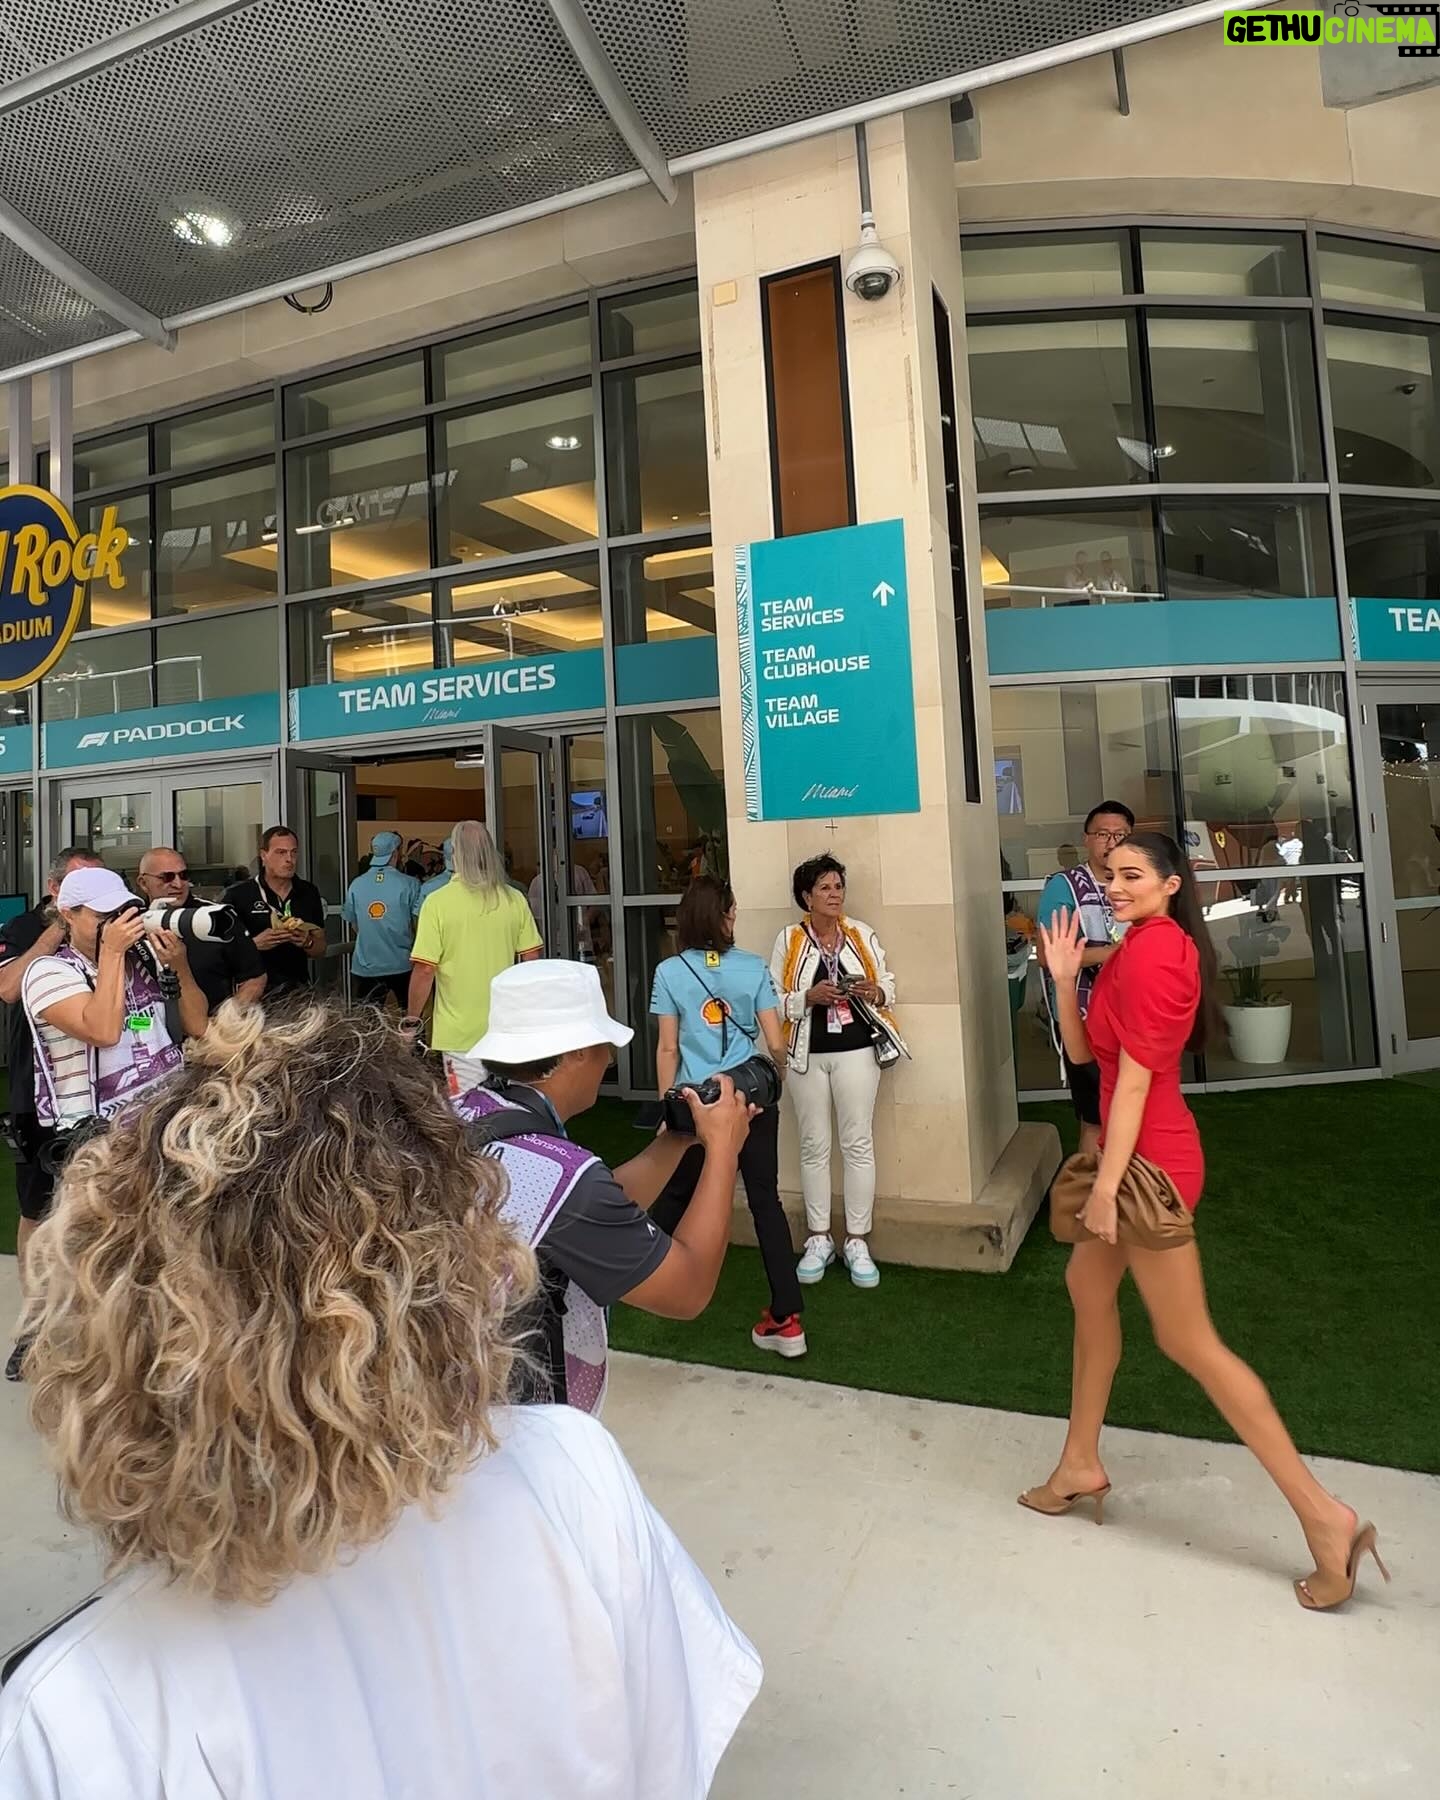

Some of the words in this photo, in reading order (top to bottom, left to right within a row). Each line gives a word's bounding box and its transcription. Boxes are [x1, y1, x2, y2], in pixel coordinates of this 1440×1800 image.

[11, 505, 129, 606] Rock
[760, 596, 813, 616] TEAM
[0, 616, 53, 644] DIUM
[761, 608, 845, 632] SERVICES
[762, 645, 816, 664] TEAM
[763, 655, 870, 680] CLUBHOUSE
[338, 681, 416, 714] TEAM
[422, 663, 556, 704] SERVICES
[764, 694, 818, 713] TEAM
[113, 714, 246, 744] PADDOCK
[765, 708, 840, 729] VILLAGE
[801, 783, 860, 802] Miami
